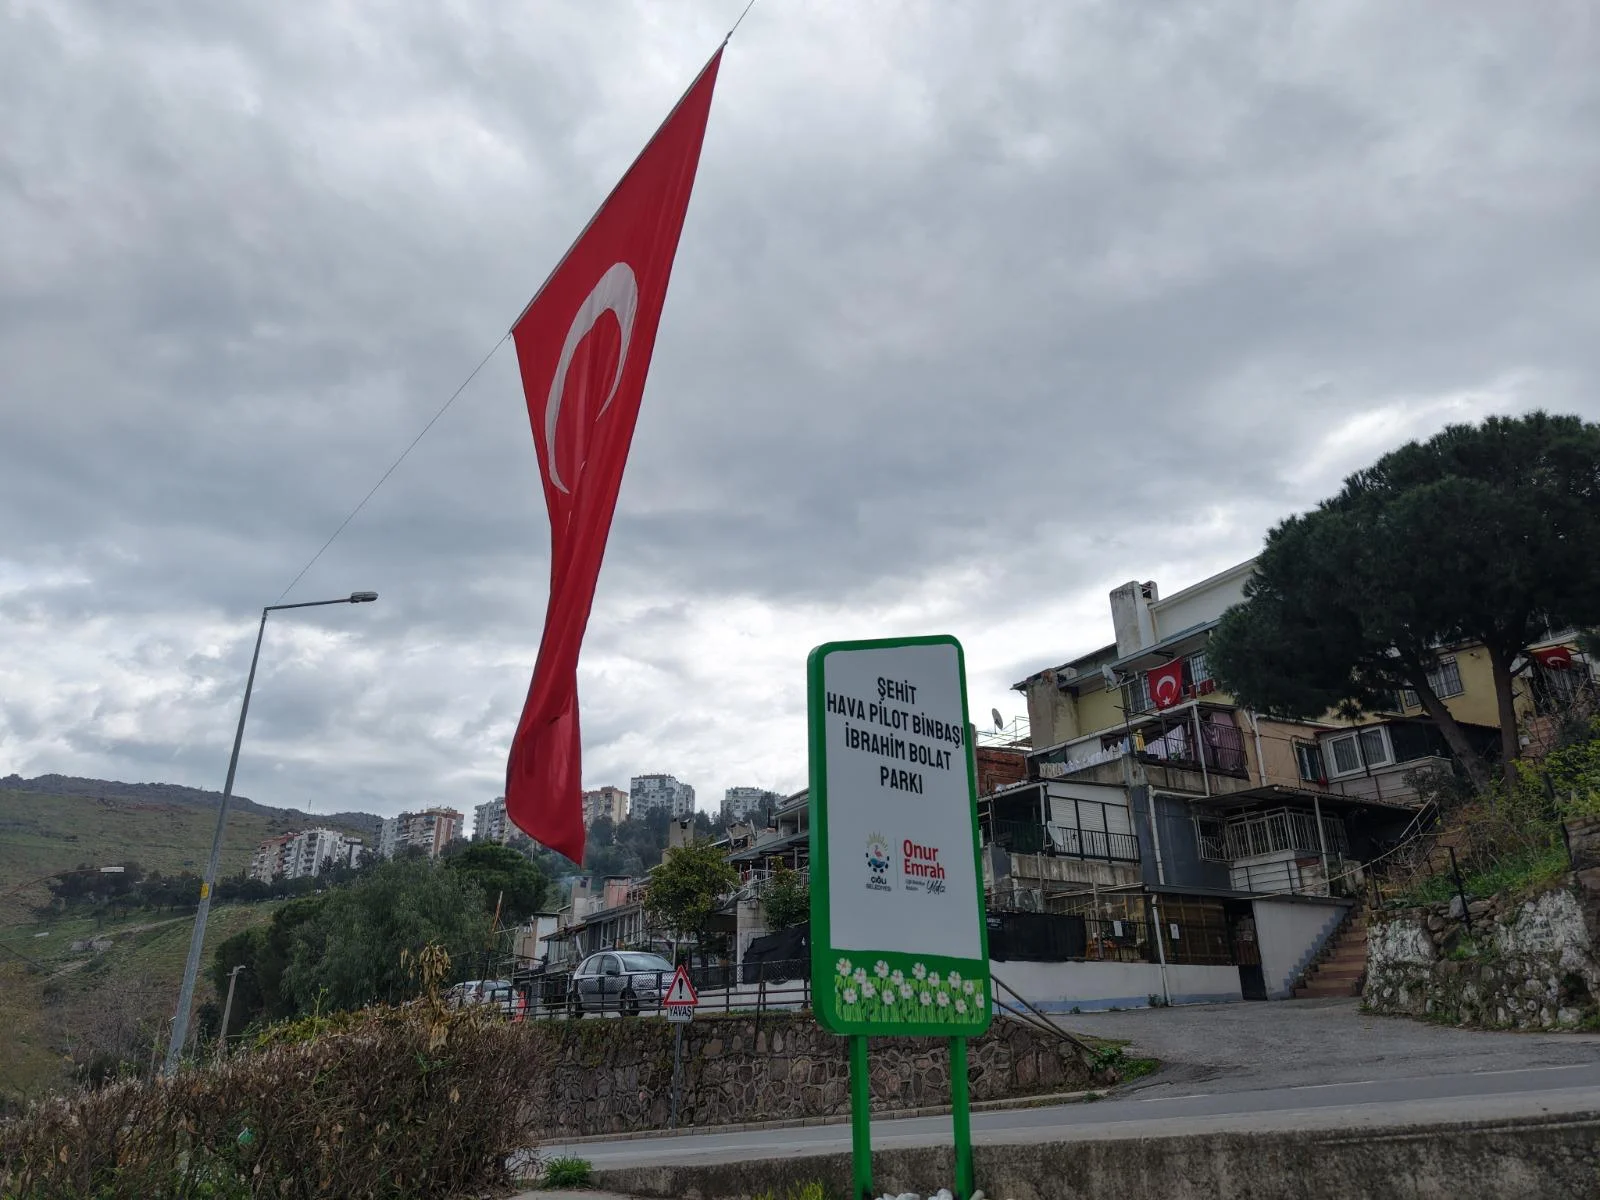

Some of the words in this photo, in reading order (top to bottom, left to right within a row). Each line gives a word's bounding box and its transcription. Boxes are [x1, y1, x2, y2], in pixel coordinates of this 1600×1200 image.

[877, 676, 917, 705] ŞEHİT
[827, 691, 866, 721] HAVA
[869, 701, 909, 731] PİLOT
[912, 712, 965, 749] BİNBAŞI
[845, 722, 906, 760] İBRAHİM
[909, 742, 951, 771] BOLAT
[880, 766, 923, 794] PARKI
[903, 839, 939, 862] Onur
[904, 858, 945, 880] Emrah
[669, 1006, 692, 1020] YAVAŞ
